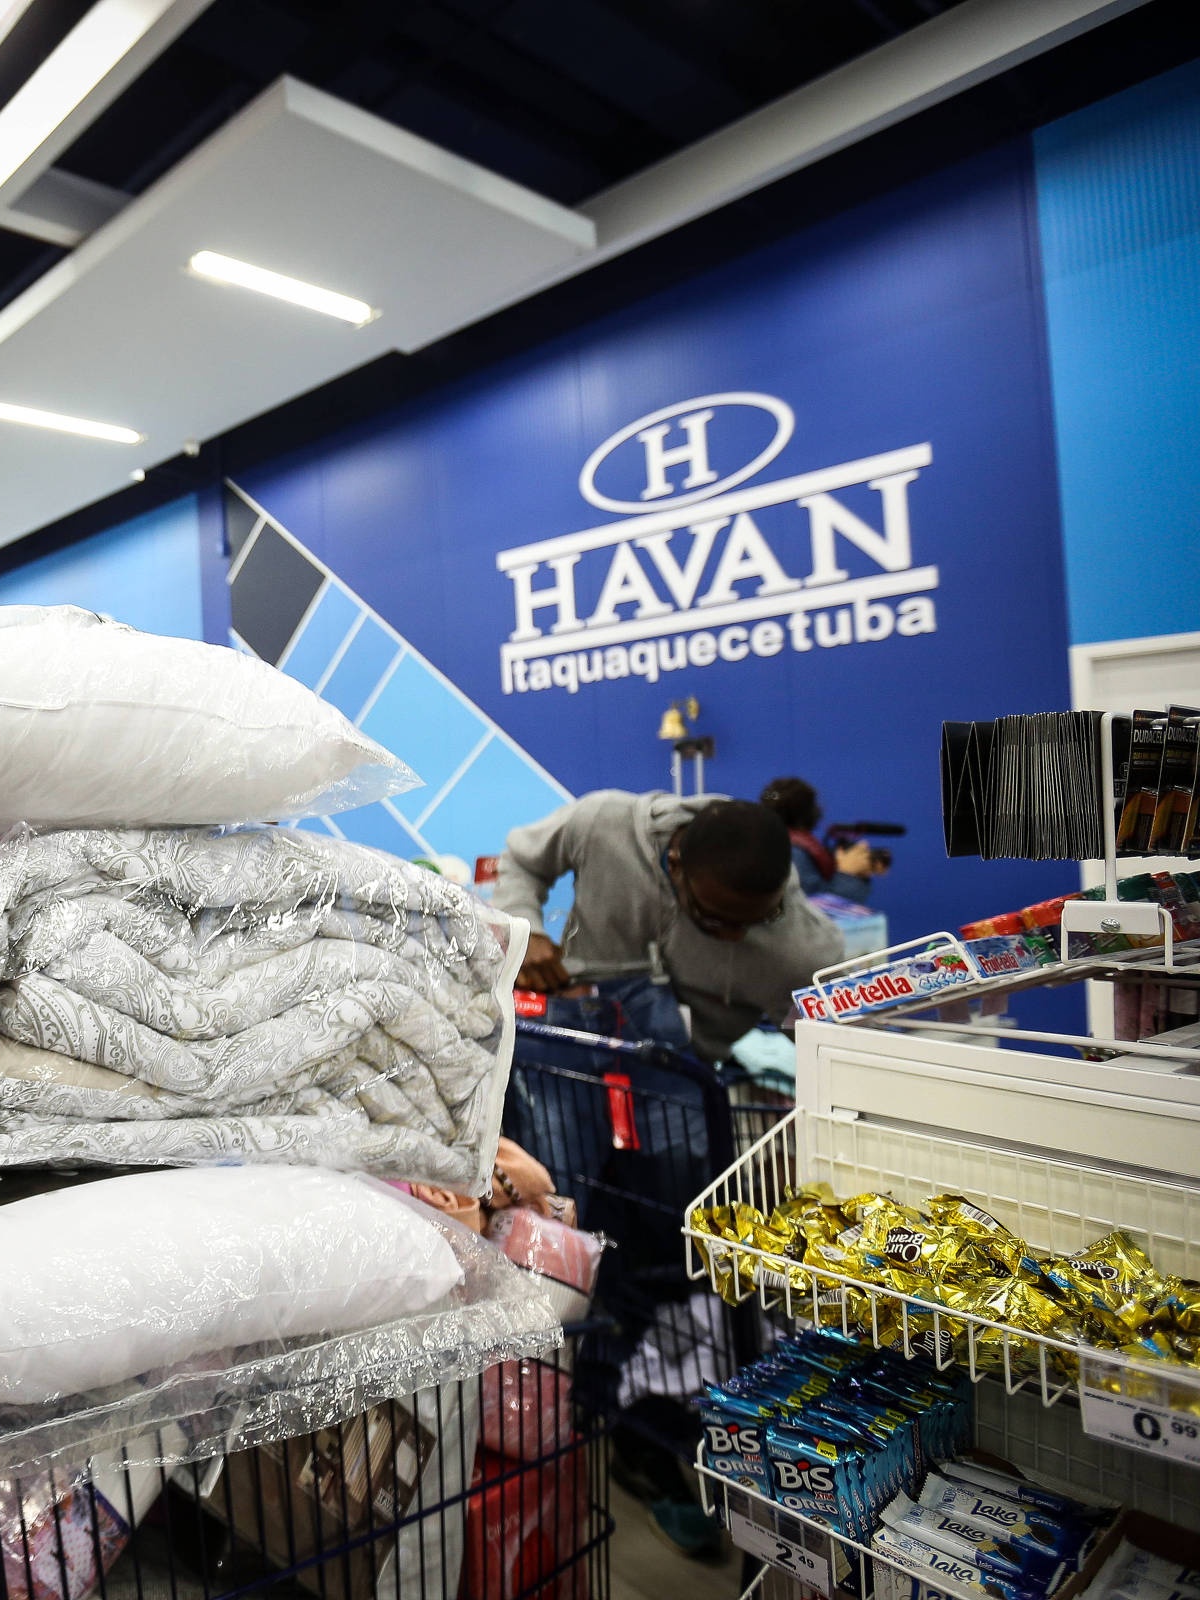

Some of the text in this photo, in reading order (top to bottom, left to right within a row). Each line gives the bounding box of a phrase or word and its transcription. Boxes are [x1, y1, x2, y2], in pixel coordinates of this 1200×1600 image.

[638, 409, 718, 501] H
[506, 469, 919, 642] HAVAN
[501, 592, 937, 695] Itaquaquecetuba
[938, 1516, 988, 1543] Laka
[971, 1497, 1021, 1526] Laka
